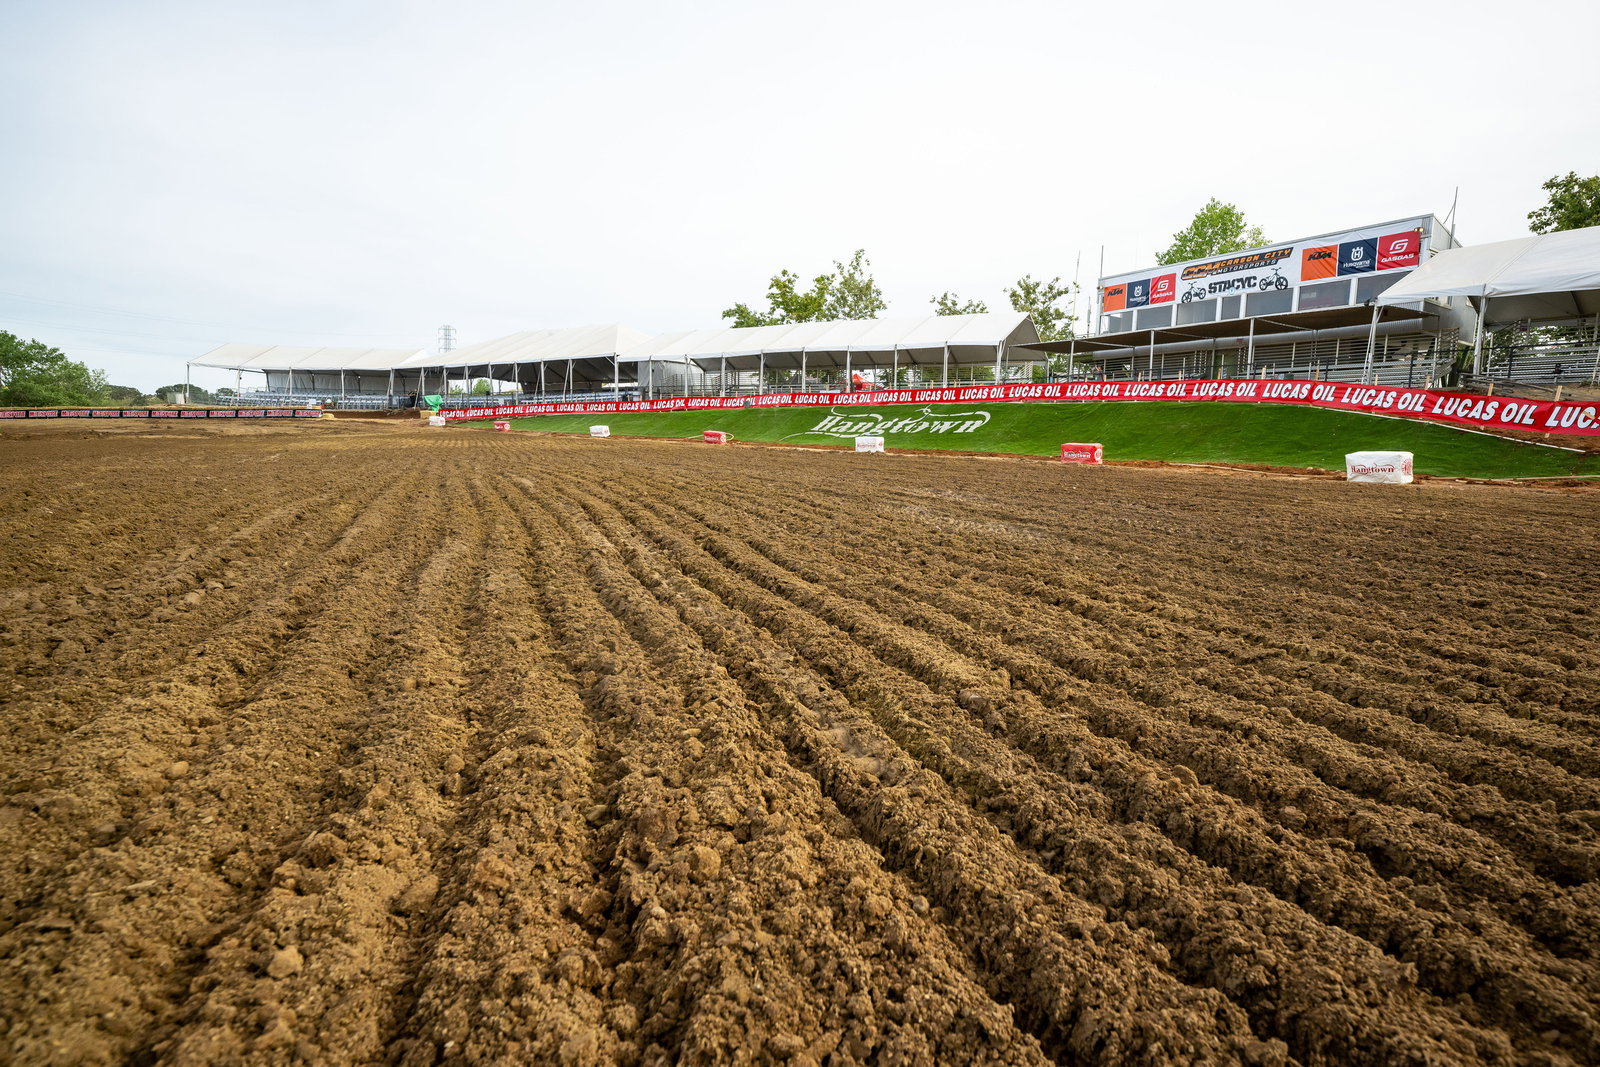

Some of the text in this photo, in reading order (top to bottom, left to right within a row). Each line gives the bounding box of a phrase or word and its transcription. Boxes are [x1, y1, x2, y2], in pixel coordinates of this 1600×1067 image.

[1220, 248, 1292, 266] CARSON CITY
[1308, 250, 1332, 261] KTM
[1381, 253, 1414, 263] GASGAS
[1218, 259, 1276, 273] MOTORSPORTS
[1108, 288, 1123, 296] KTM
[1208, 276, 1257, 294] STACYC
[653, 400, 674, 408] LUCAS
[676, 400, 685, 408] OIL
[687, 399, 709, 407] LUCAS
[710, 398, 721, 406] OIL
[723, 398, 744, 406] LUCAS
[758, 396, 780, 404] LUCAS
[781, 395, 792, 403] OIL
[795, 395, 817, 403] LUCAS
[818, 395, 830, 404] OIL
[833, 394, 857, 404] LUCAS
[859, 393, 871, 402] OIL
[873, 392, 898, 402] LUCAS
[899, 392, 912, 401] OIL
[915, 391, 941, 401] LUCAS
[943, 390, 956, 400] OIL
[960, 388, 988, 400] LUCAS
[990, 387, 1004, 398] OIL
[1009, 386, 1042, 397] LUCAS
[1044, 385, 1061, 396] OIL
[1066, 384, 1100, 396] LUCAS
[1102, 384, 1120, 396] OIL
[1124, 383, 1165, 396] LUCAS
[1166, 383, 1186, 397] OIL
[1192, 382, 1235, 397] LUCAS
[1236, 382, 1258, 397] OIL
[1262, 382, 1311, 400] LUCAS
[1312, 384, 1336, 402] OIL
[1341, 387, 1397, 409] LUCAS
[1397, 392, 1427, 412] OIL
[1432, 396, 1499, 421] LUCAS
[1500, 402, 1538, 425] OIL
[1544, 406, 1600, 429] LUC
[810, 413, 990, 436] Hangtown
[1350, 464, 1395, 475] Hangtown
